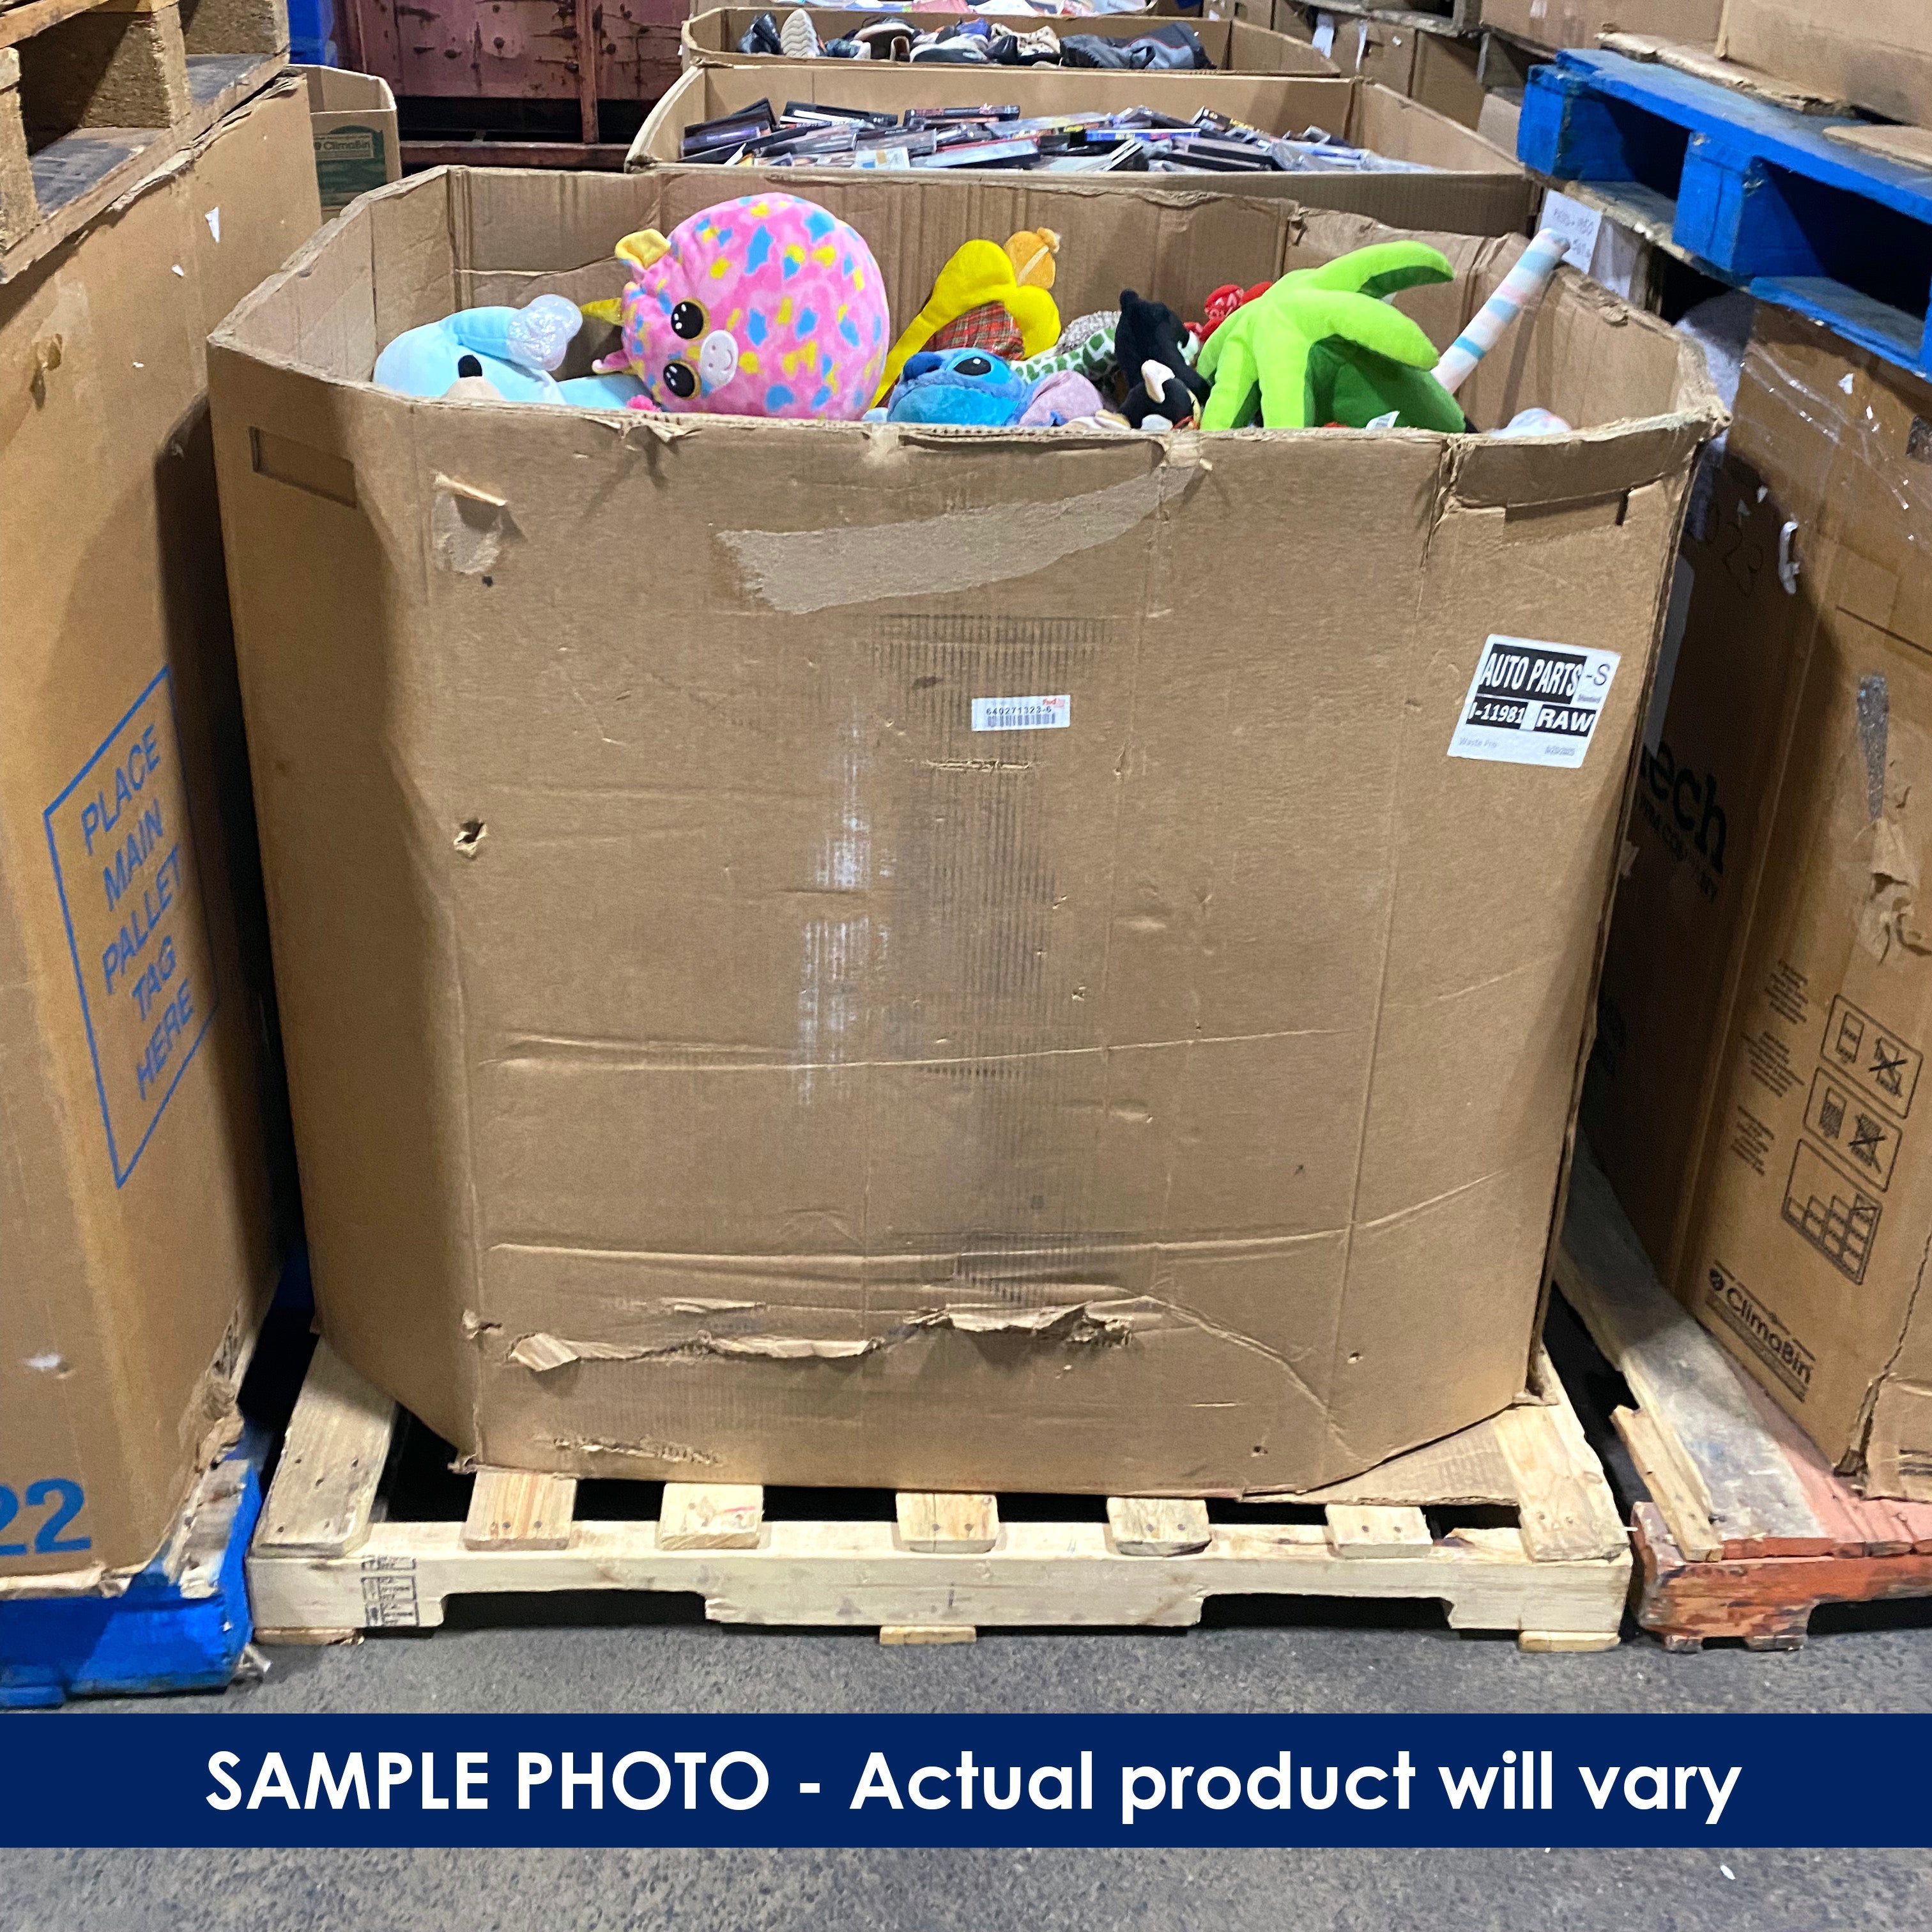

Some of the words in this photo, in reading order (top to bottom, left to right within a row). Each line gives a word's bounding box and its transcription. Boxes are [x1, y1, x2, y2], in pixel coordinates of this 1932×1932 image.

[1480, 653, 1529, 690] AUTO
[1526, 659, 1584, 696] PARTS
[1537, 708, 1596, 732] RAW
[81, 724, 160, 856] PLACE
[103, 798, 163, 912] MAIN
[102, 844, 181, 996] PALLET
[132, 935, 176, 1022] TAG
[136, 978, 194, 1101] HERE
